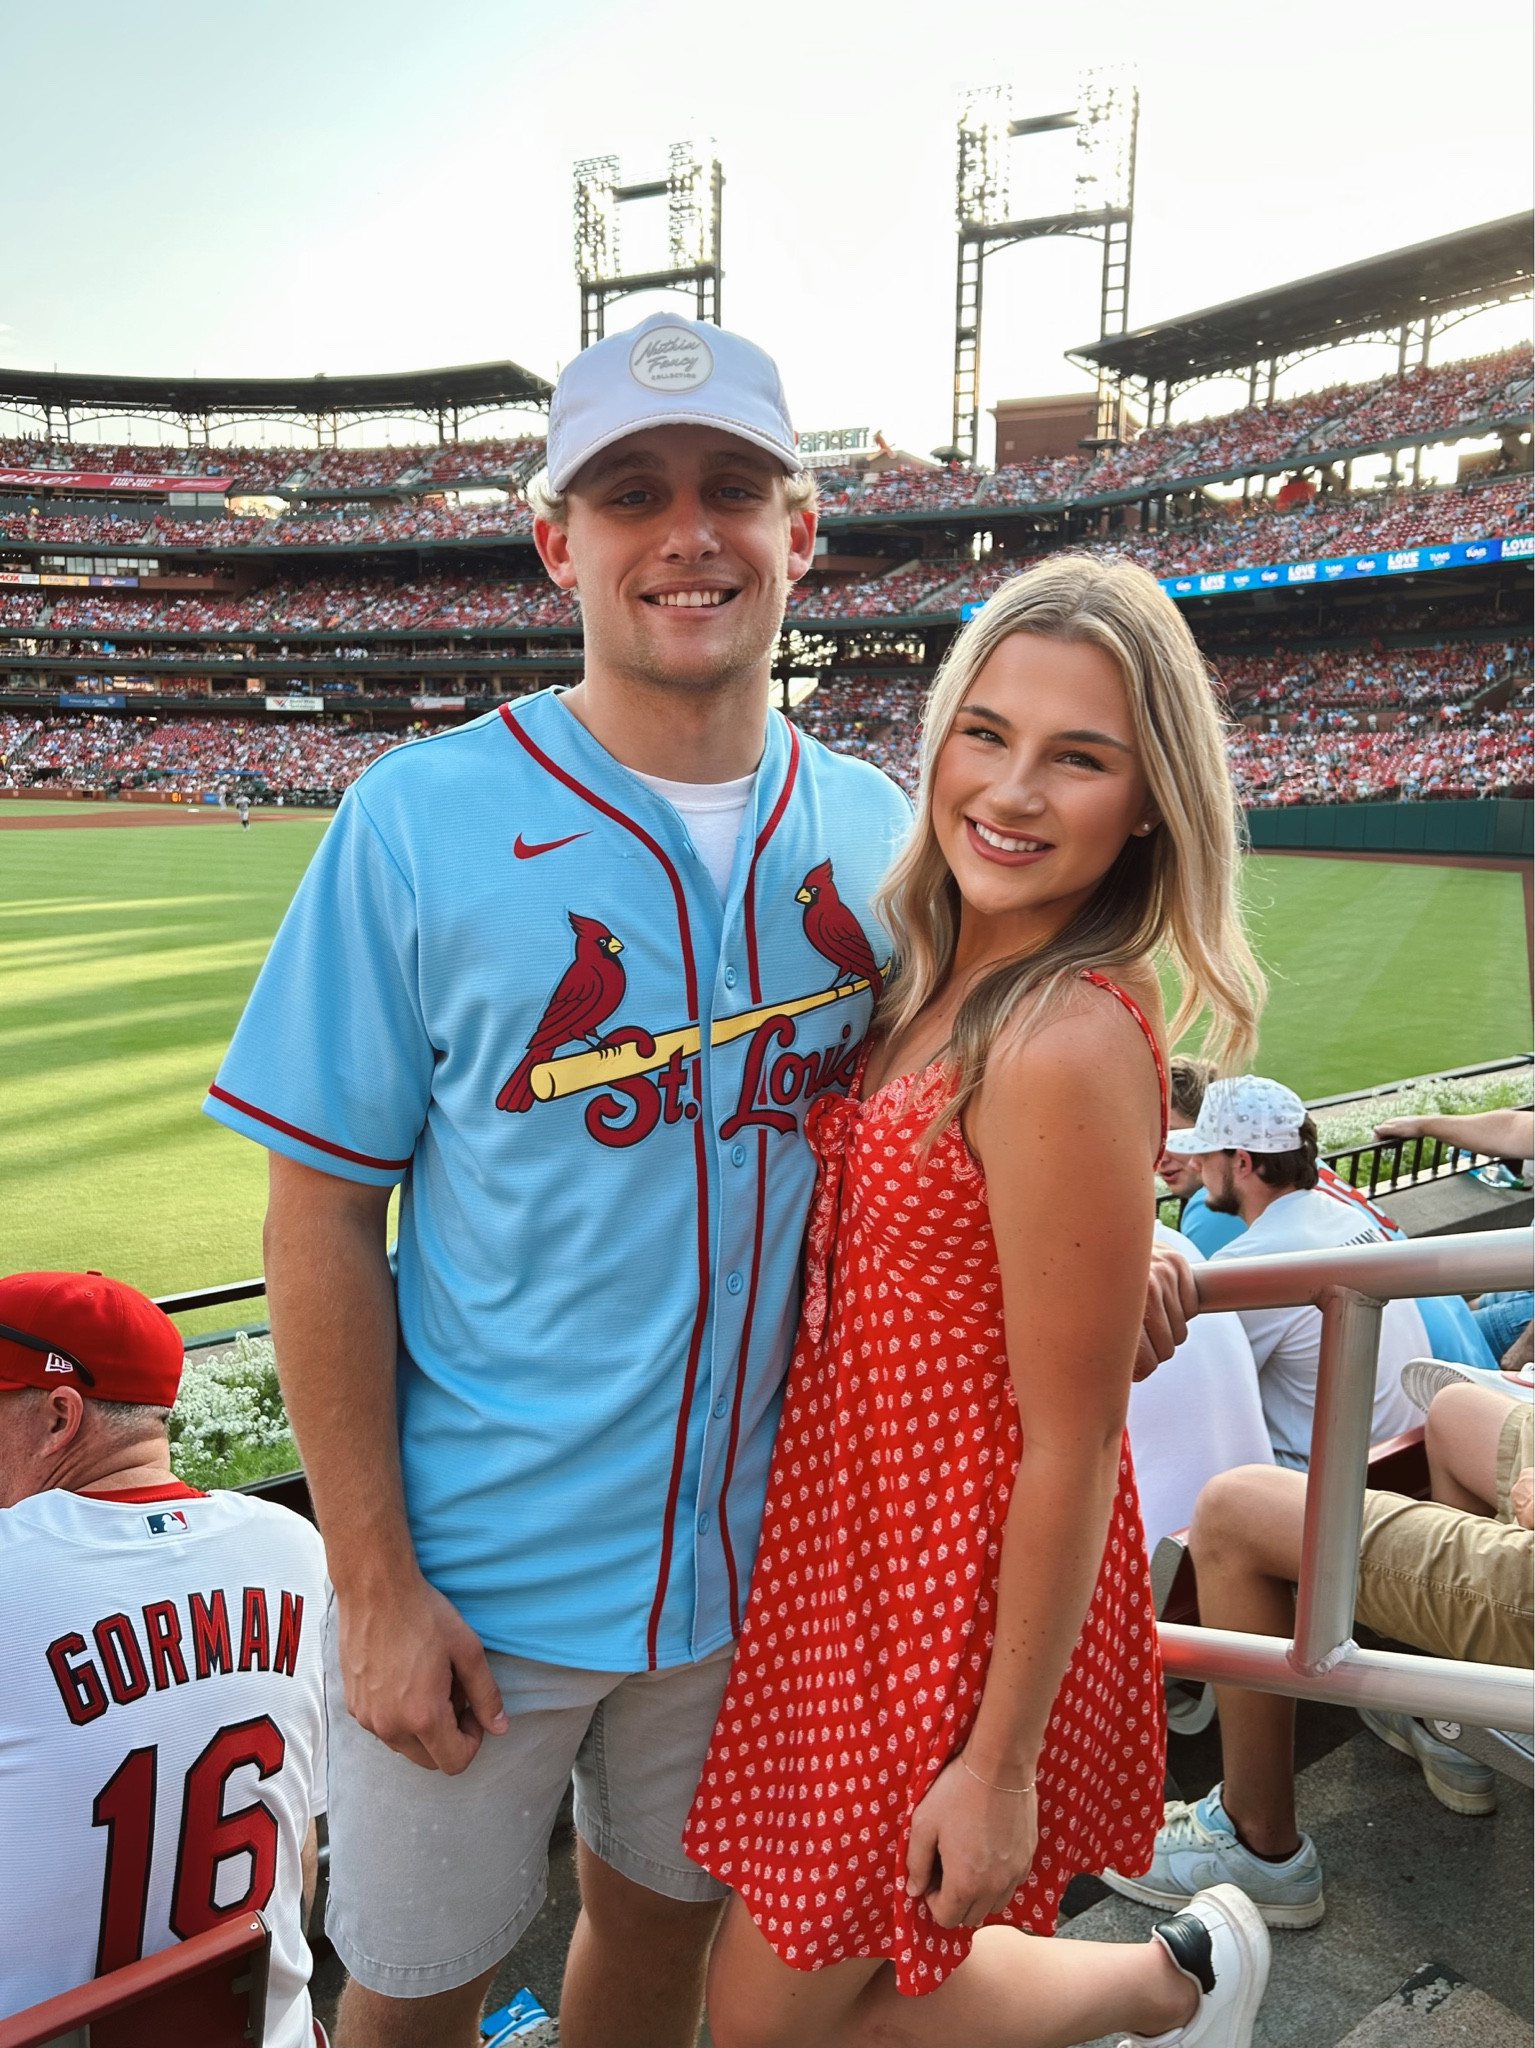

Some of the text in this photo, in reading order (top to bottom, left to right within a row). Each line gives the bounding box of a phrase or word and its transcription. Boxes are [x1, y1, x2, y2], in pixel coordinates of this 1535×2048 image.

[646, 355, 699, 373] Fancy
[585, 1025, 700, 1148] St.
[45, 1586, 304, 1726] GORMAN
[92, 1713, 286, 1978] 16
